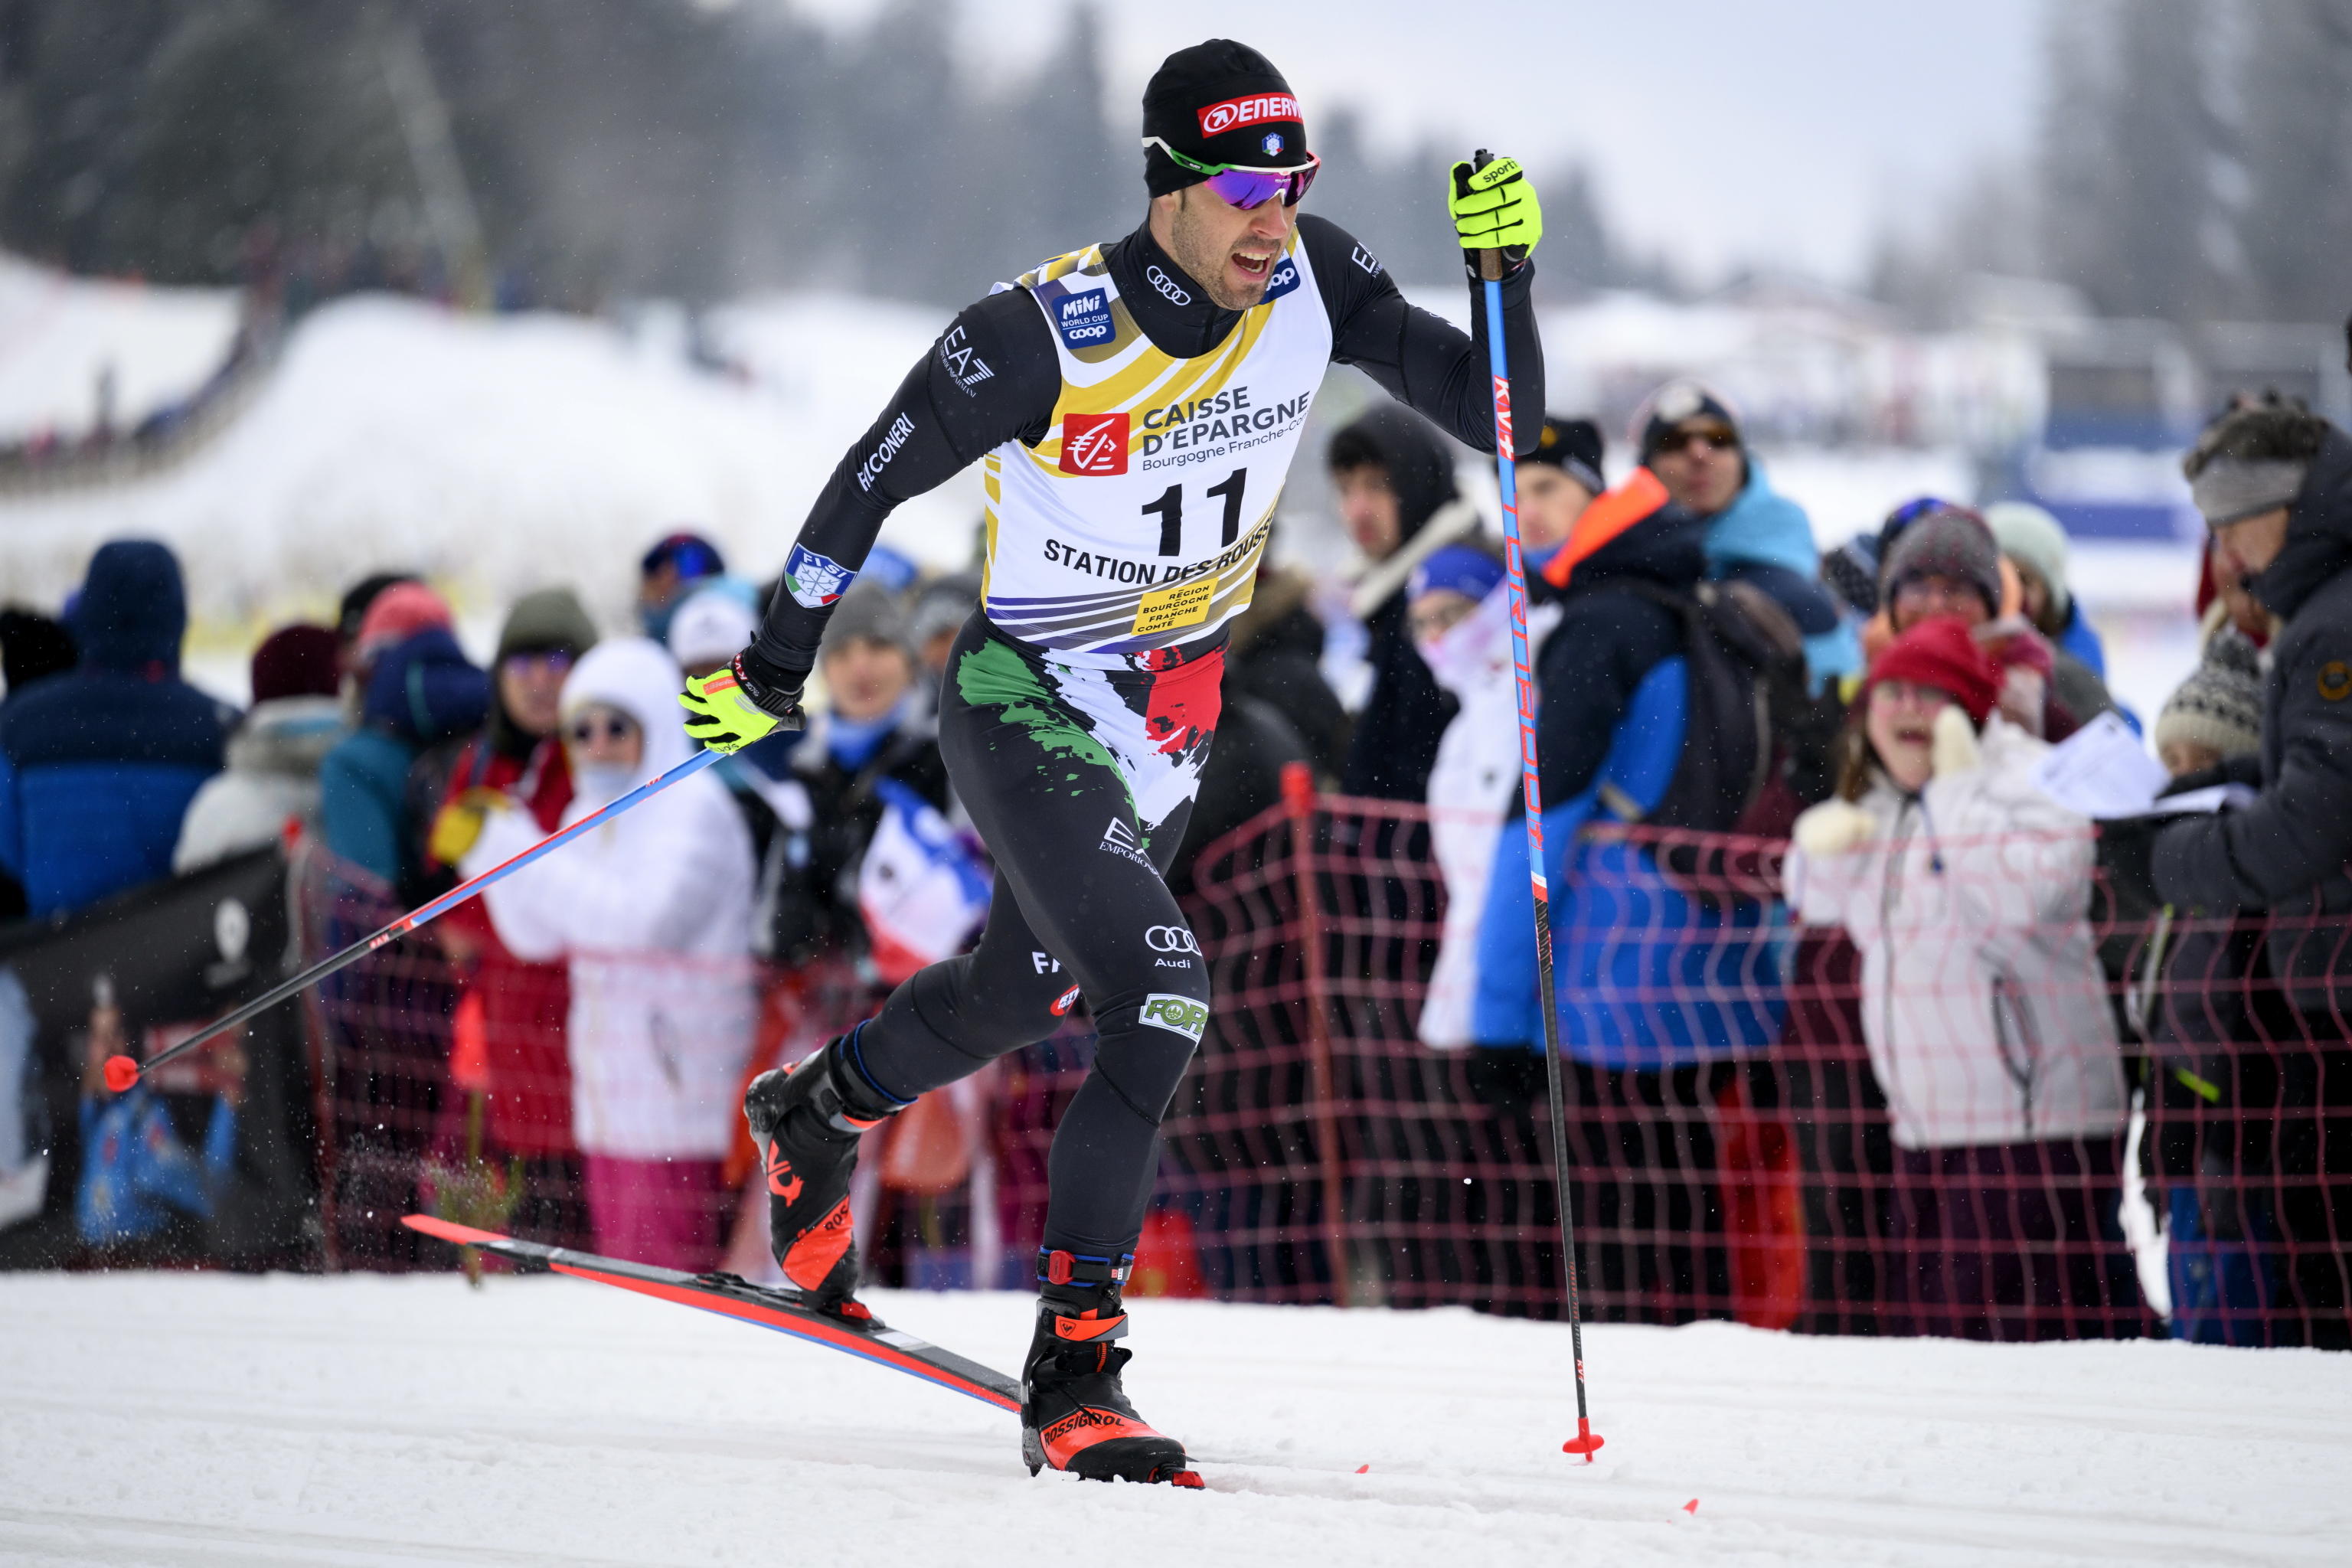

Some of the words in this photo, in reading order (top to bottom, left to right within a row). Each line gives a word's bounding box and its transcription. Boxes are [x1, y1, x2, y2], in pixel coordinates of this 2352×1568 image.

[1060, 317, 1090, 328] WORLD
[1092, 314, 1109, 322] CUP
[1069, 325, 1107, 339] coop
[1143, 386, 1250, 430] CAISSE
[1142, 447, 1225, 472] Bourgogne
[1142, 467, 1247, 557] 11
[803, 552, 848, 579] FISI
[1044, 538, 1156, 585] STATION
[1162, 559, 1212, 583] DES
[1143, 593, 1210, 614] BOURGOGNE
[1149, 606, 1199, 622] FRANCHE
[1098, 841, 1148, 867] EMPORIO
[1154, 958, 1191, 969] Audi
